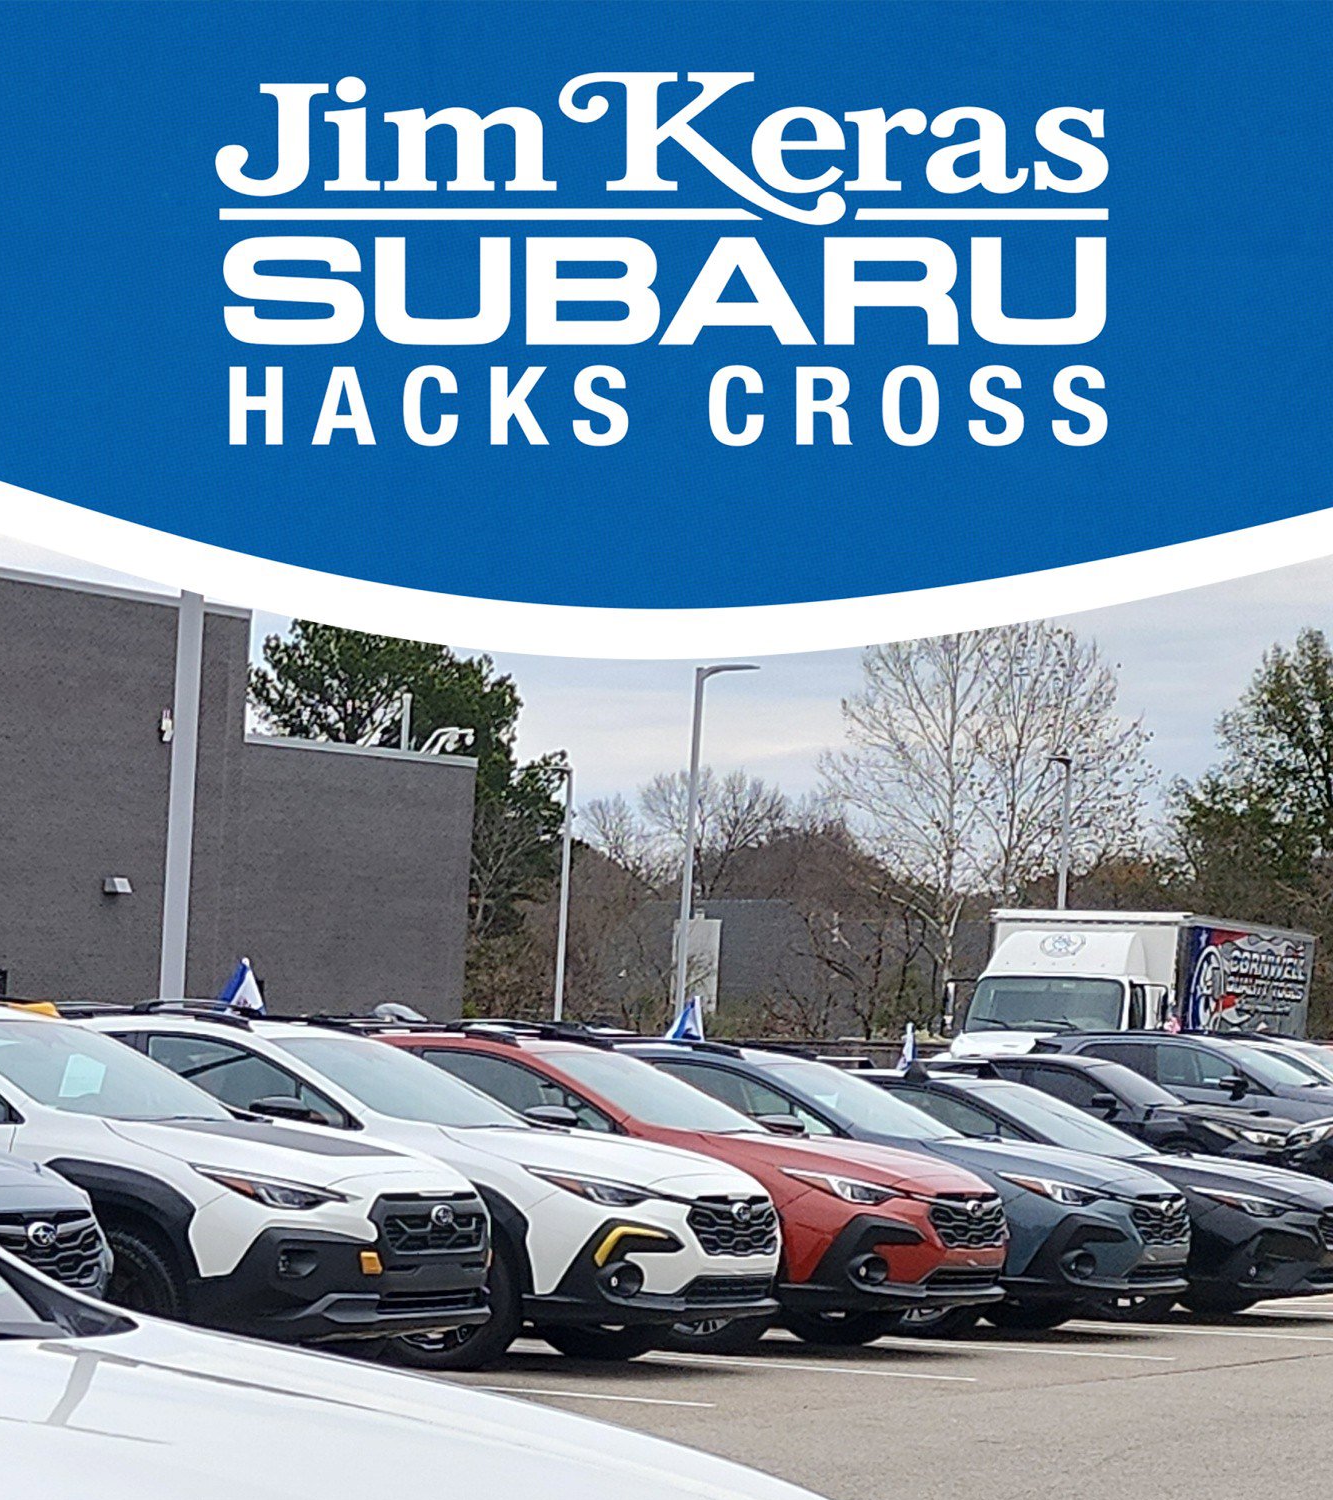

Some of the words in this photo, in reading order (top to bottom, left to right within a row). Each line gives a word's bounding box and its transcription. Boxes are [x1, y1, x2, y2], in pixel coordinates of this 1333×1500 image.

[1230, 949, 1306, 981] CORNWELL
[1226, 975, 1270, 997] QUALITY
[1271, 981, 1304, 1001] TOOLS
